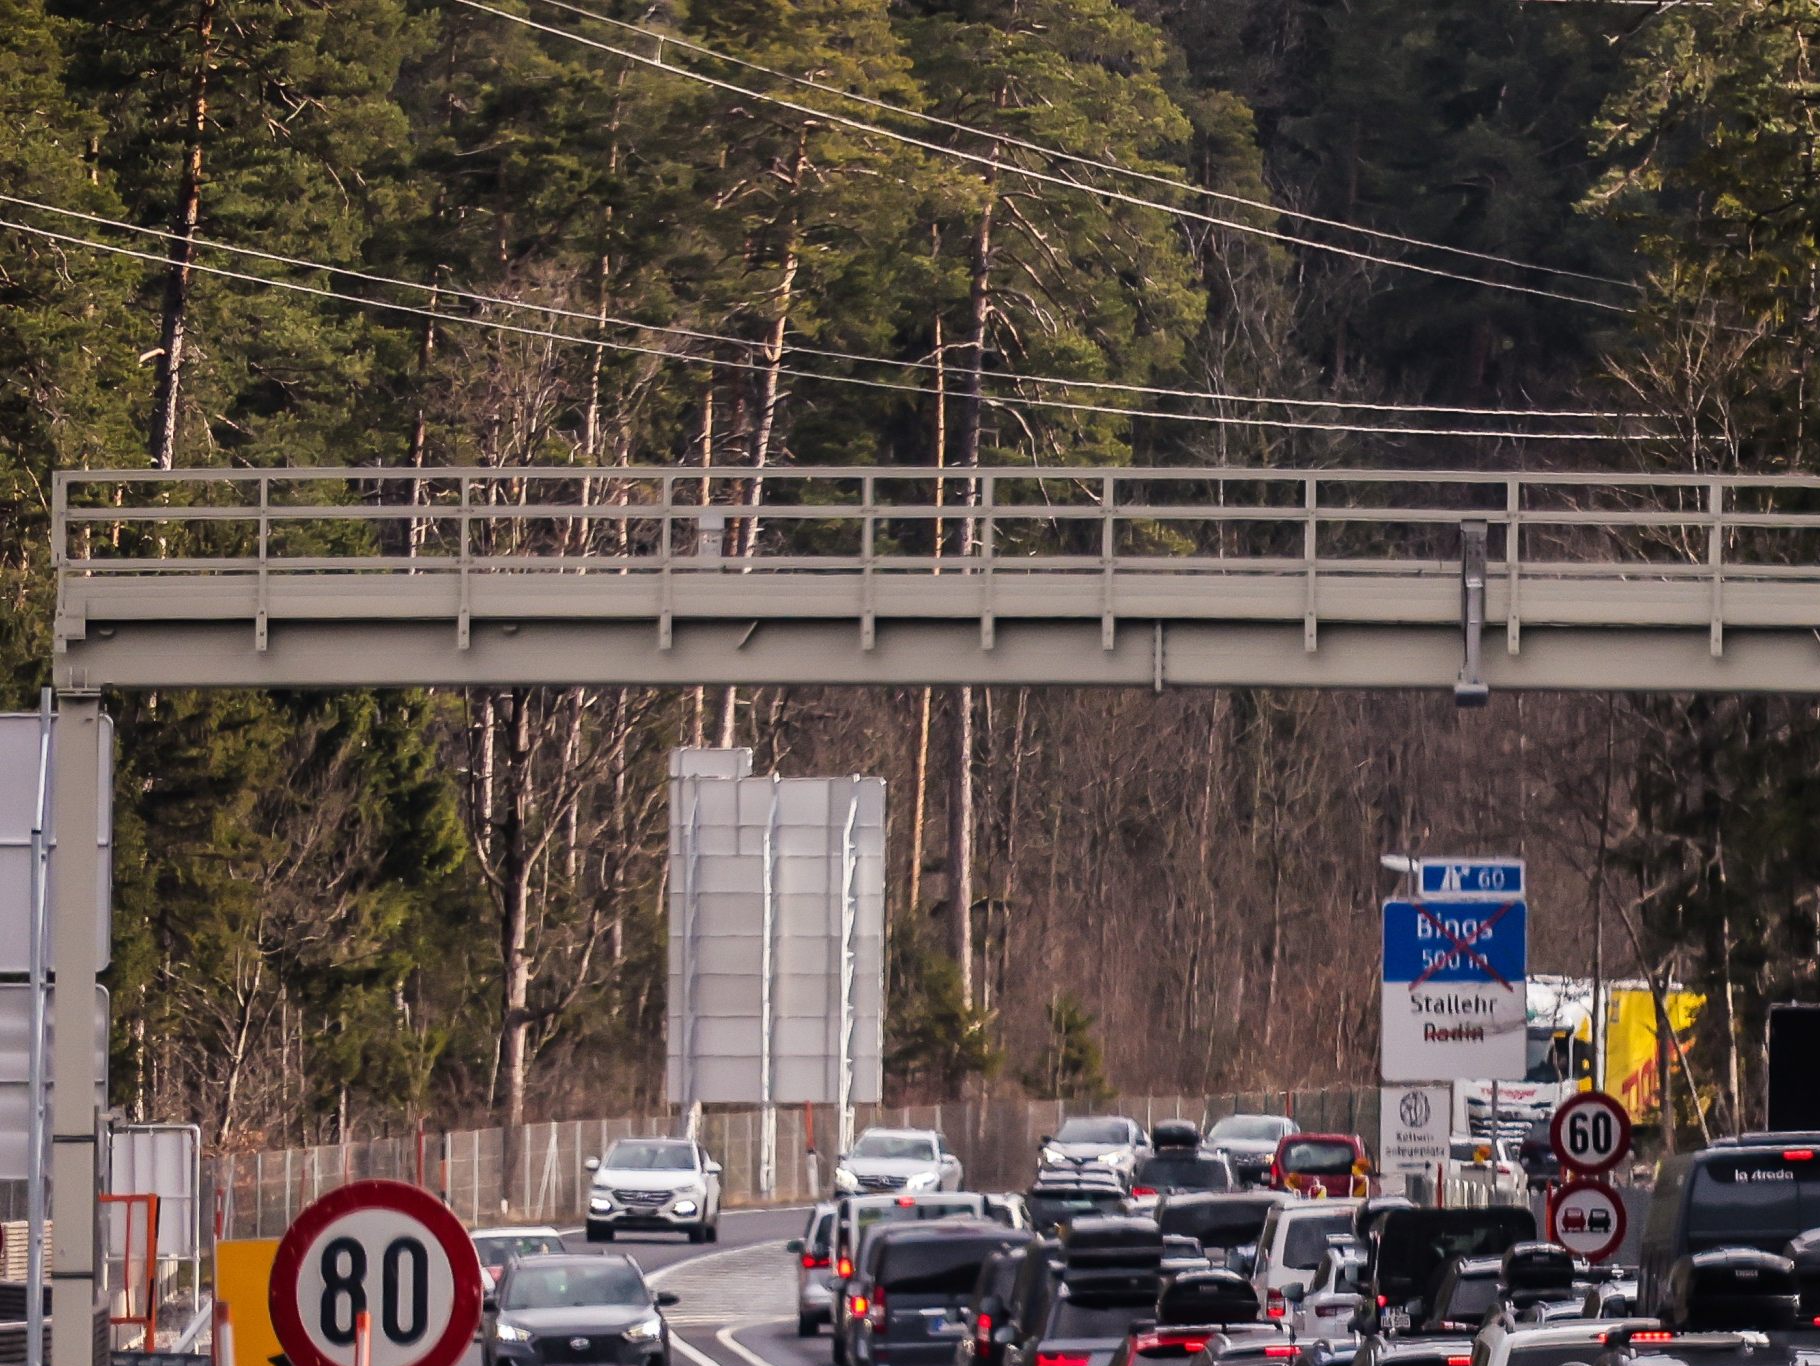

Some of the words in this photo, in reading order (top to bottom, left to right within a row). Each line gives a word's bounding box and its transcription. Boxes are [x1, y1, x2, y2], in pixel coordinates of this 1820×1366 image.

[1478, 868, 1505, 890] 60
[1416, 911, 1494, 945] Bings
[1422, 948, 1461, 971] 500
[1410, 993, 1498, 1015] Stallehr
[1569, 1111, 1611, 1155] 60
[1752, 1169, 1794, 1181] strada
[320, 1236, 428, 1347] 80
